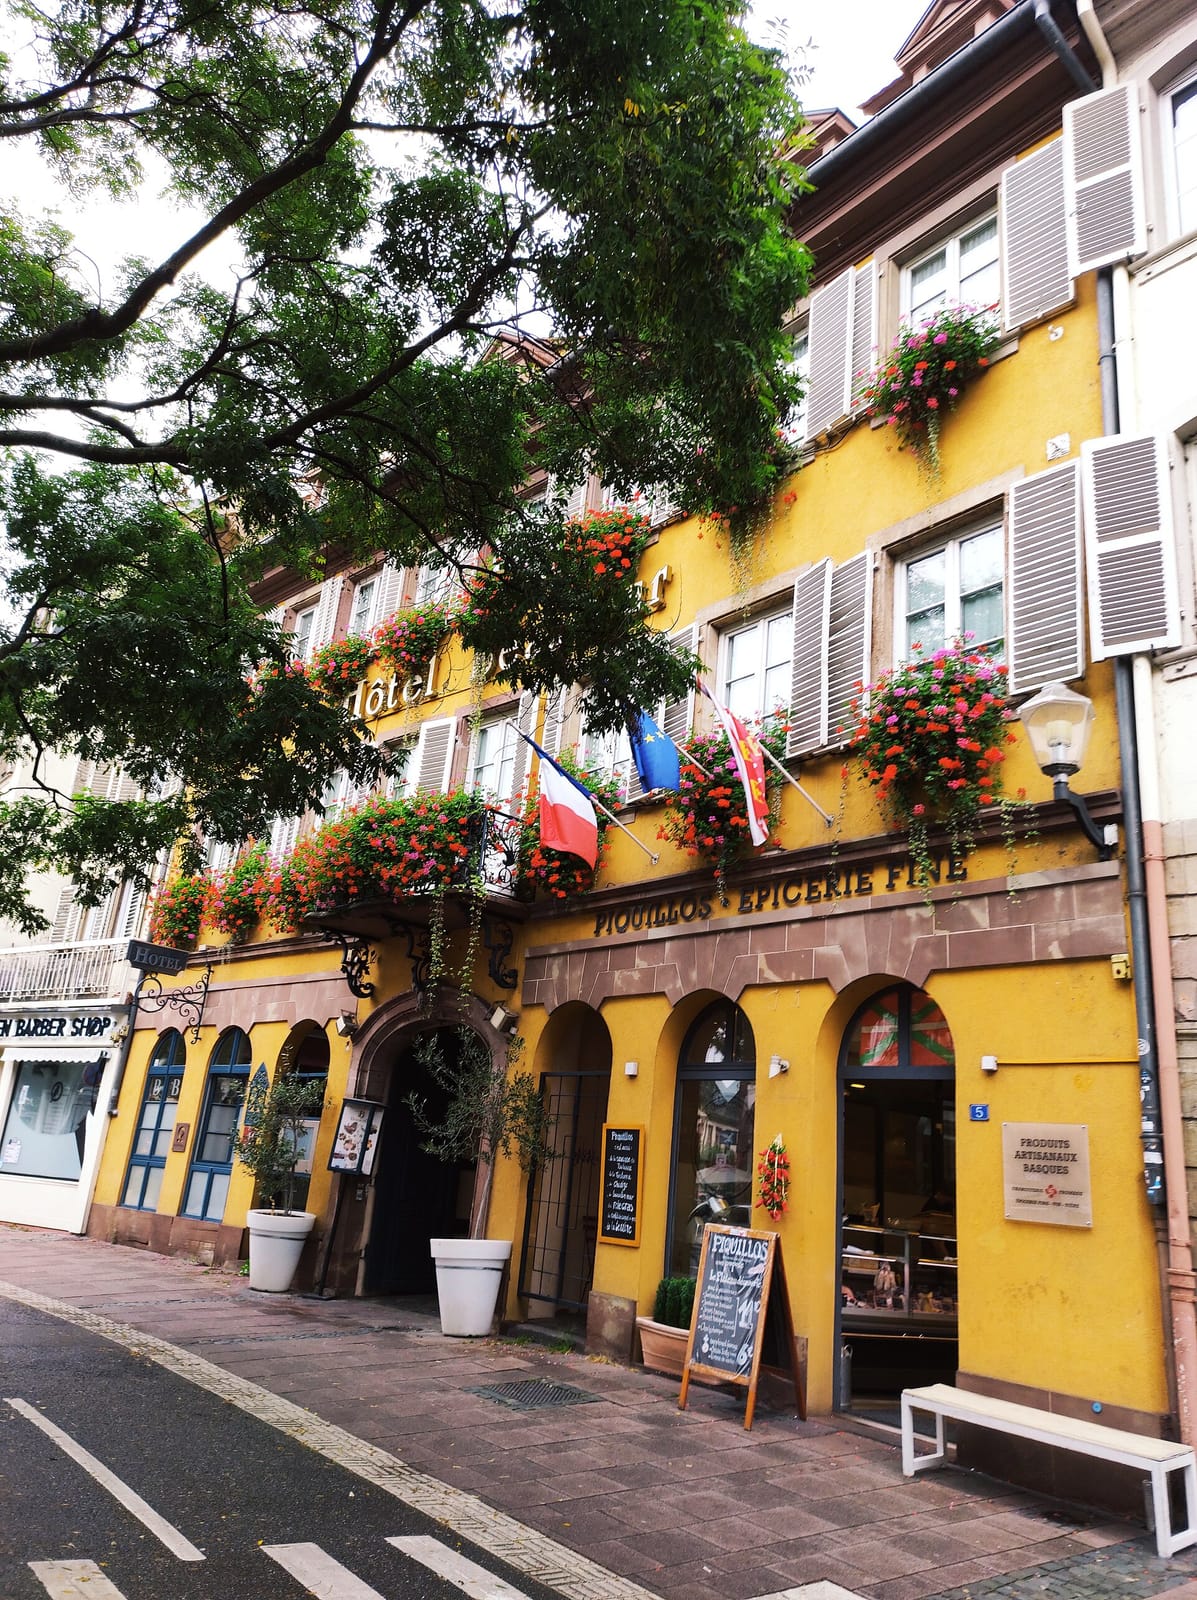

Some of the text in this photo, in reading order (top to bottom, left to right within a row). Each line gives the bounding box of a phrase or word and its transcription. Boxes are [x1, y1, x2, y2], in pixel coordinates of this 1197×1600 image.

[593, 853, 968, 935] PIQUILLOS EPICERIE FINE
[134, 946, 184, 971] HOTEL
[15, 1017, 66, 1037] BARBER
[975, 1106, 984, 1118] 5
[1020, 1138, 1070, 1149] PRODUITS
[1014, 1150, 1078, 1162] ARTISANAUX
[1023, 1163, 1069, 1175] BASQUES
[711, 1234, 769, 1262] PIQUILLOS
